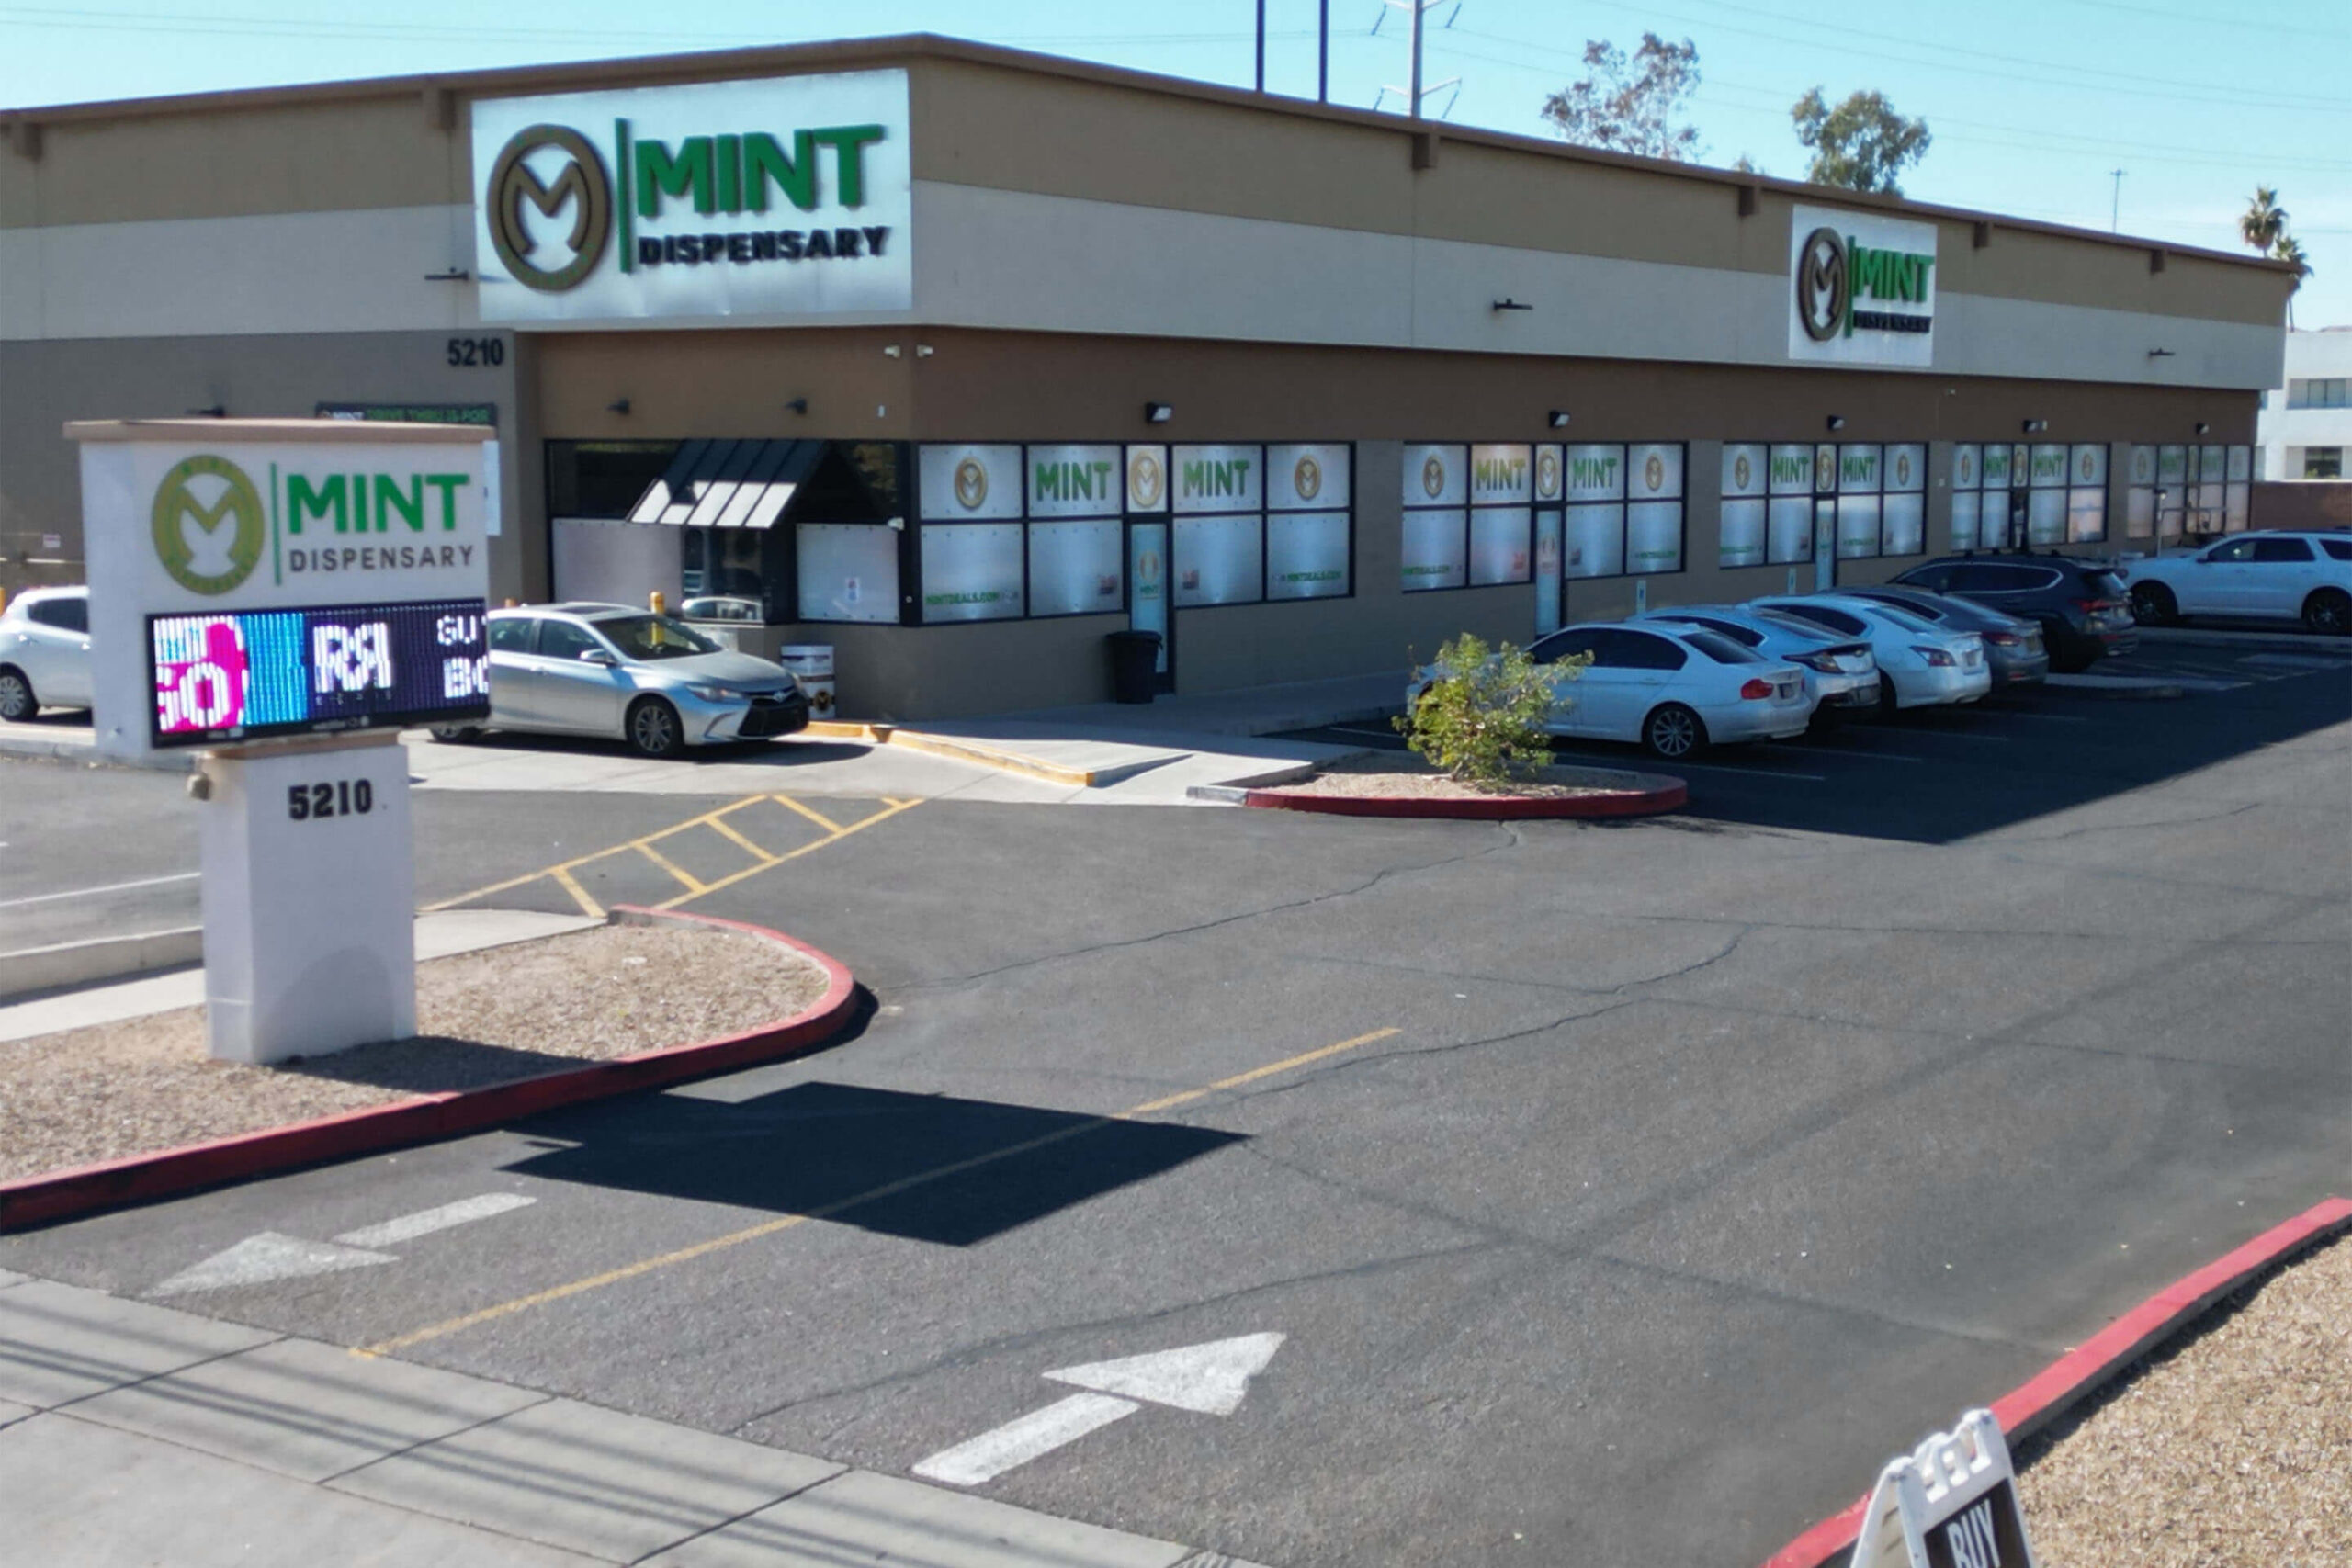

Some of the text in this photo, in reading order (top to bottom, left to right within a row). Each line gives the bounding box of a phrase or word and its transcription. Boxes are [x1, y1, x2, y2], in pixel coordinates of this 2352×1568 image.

[635, 123, 886, 218] MINT
[637, 226, 890, 265] DISPENSARY
[1853, 246, 1936, 303] MINT
[447, 338, 505, 367] 5210
[1035, 460, 1113, 502] MINT
[1182, 459, 1250, 498] MINT
[1476, 457, 1526, 491] MINT
[1572, 457, 1618, 489] MINT
[1771, 456, 1809, 483] MINT
[1842, 455, 1876, 482] MINT
[287, 473, 470, 535] MINT
[289, 544, 474, 572] DISPENSARY
[288, 779, 372, 821] 5210
[1946, 1498, 2002, 1568] BUY
